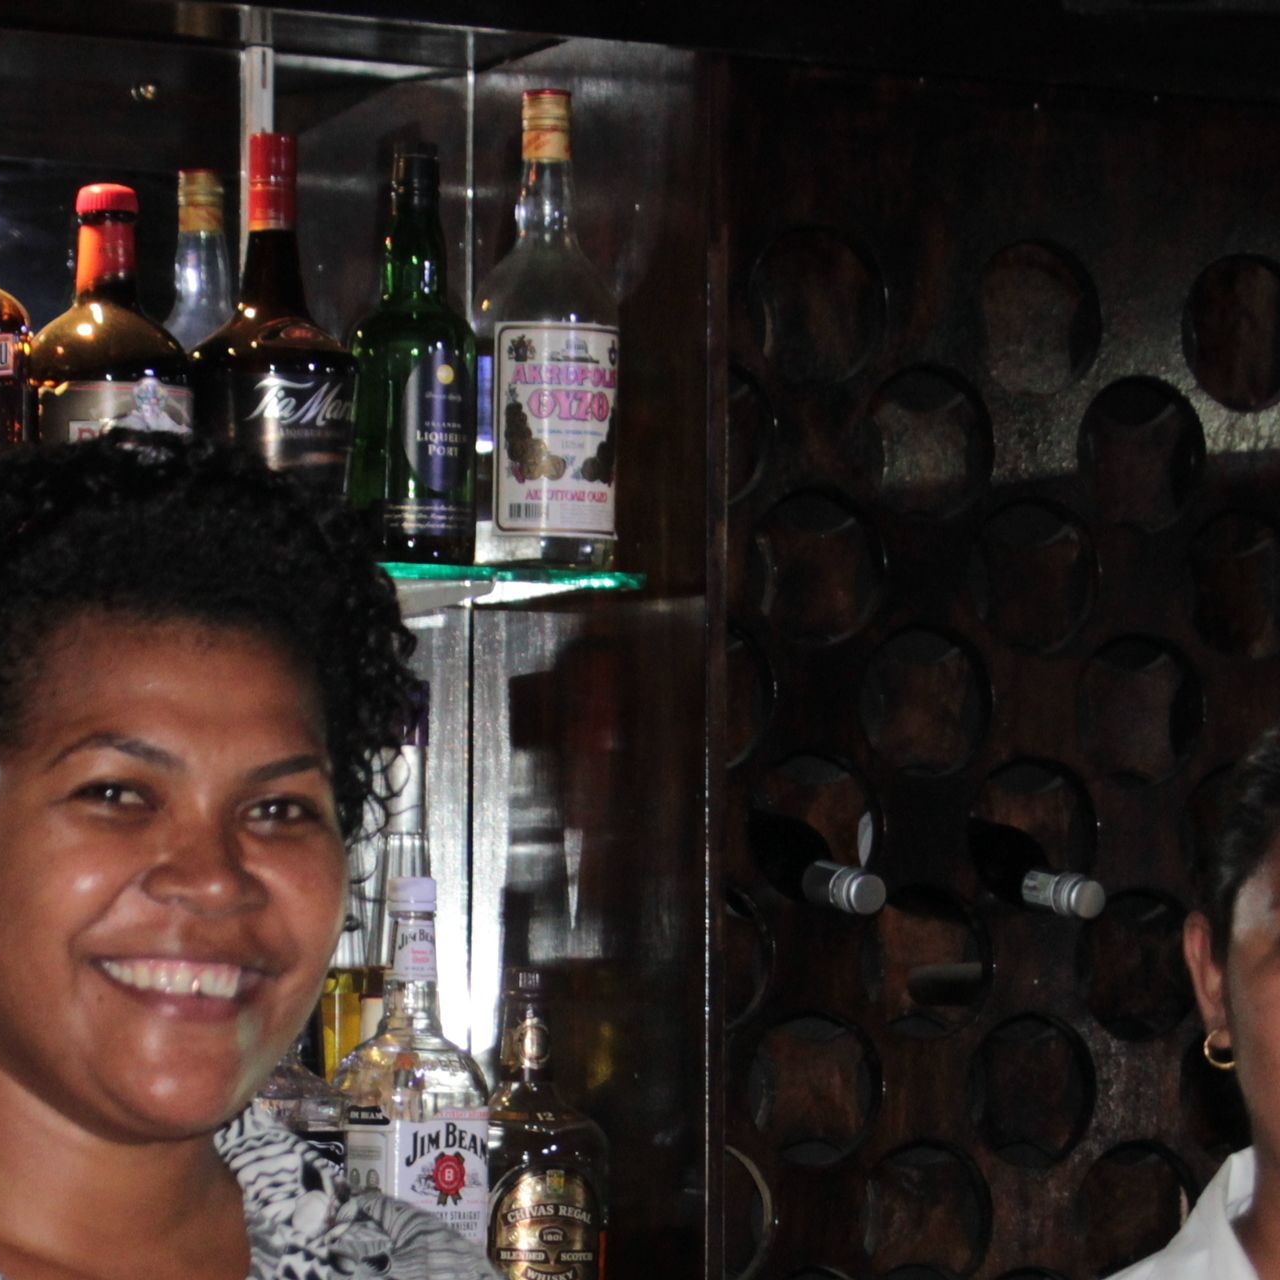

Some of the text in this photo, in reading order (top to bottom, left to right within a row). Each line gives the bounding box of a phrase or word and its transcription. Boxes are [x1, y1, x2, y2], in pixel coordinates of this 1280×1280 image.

[245, 377, 314, 420] Tia
[536, 1112, 556, 1122] 12
[404, 1130, 441, 1168] JIM
[507, 1204, 592, 1225] CHIVAS REGAL
[500, 1251, 593, 1262] BLENDED SCOTCH
